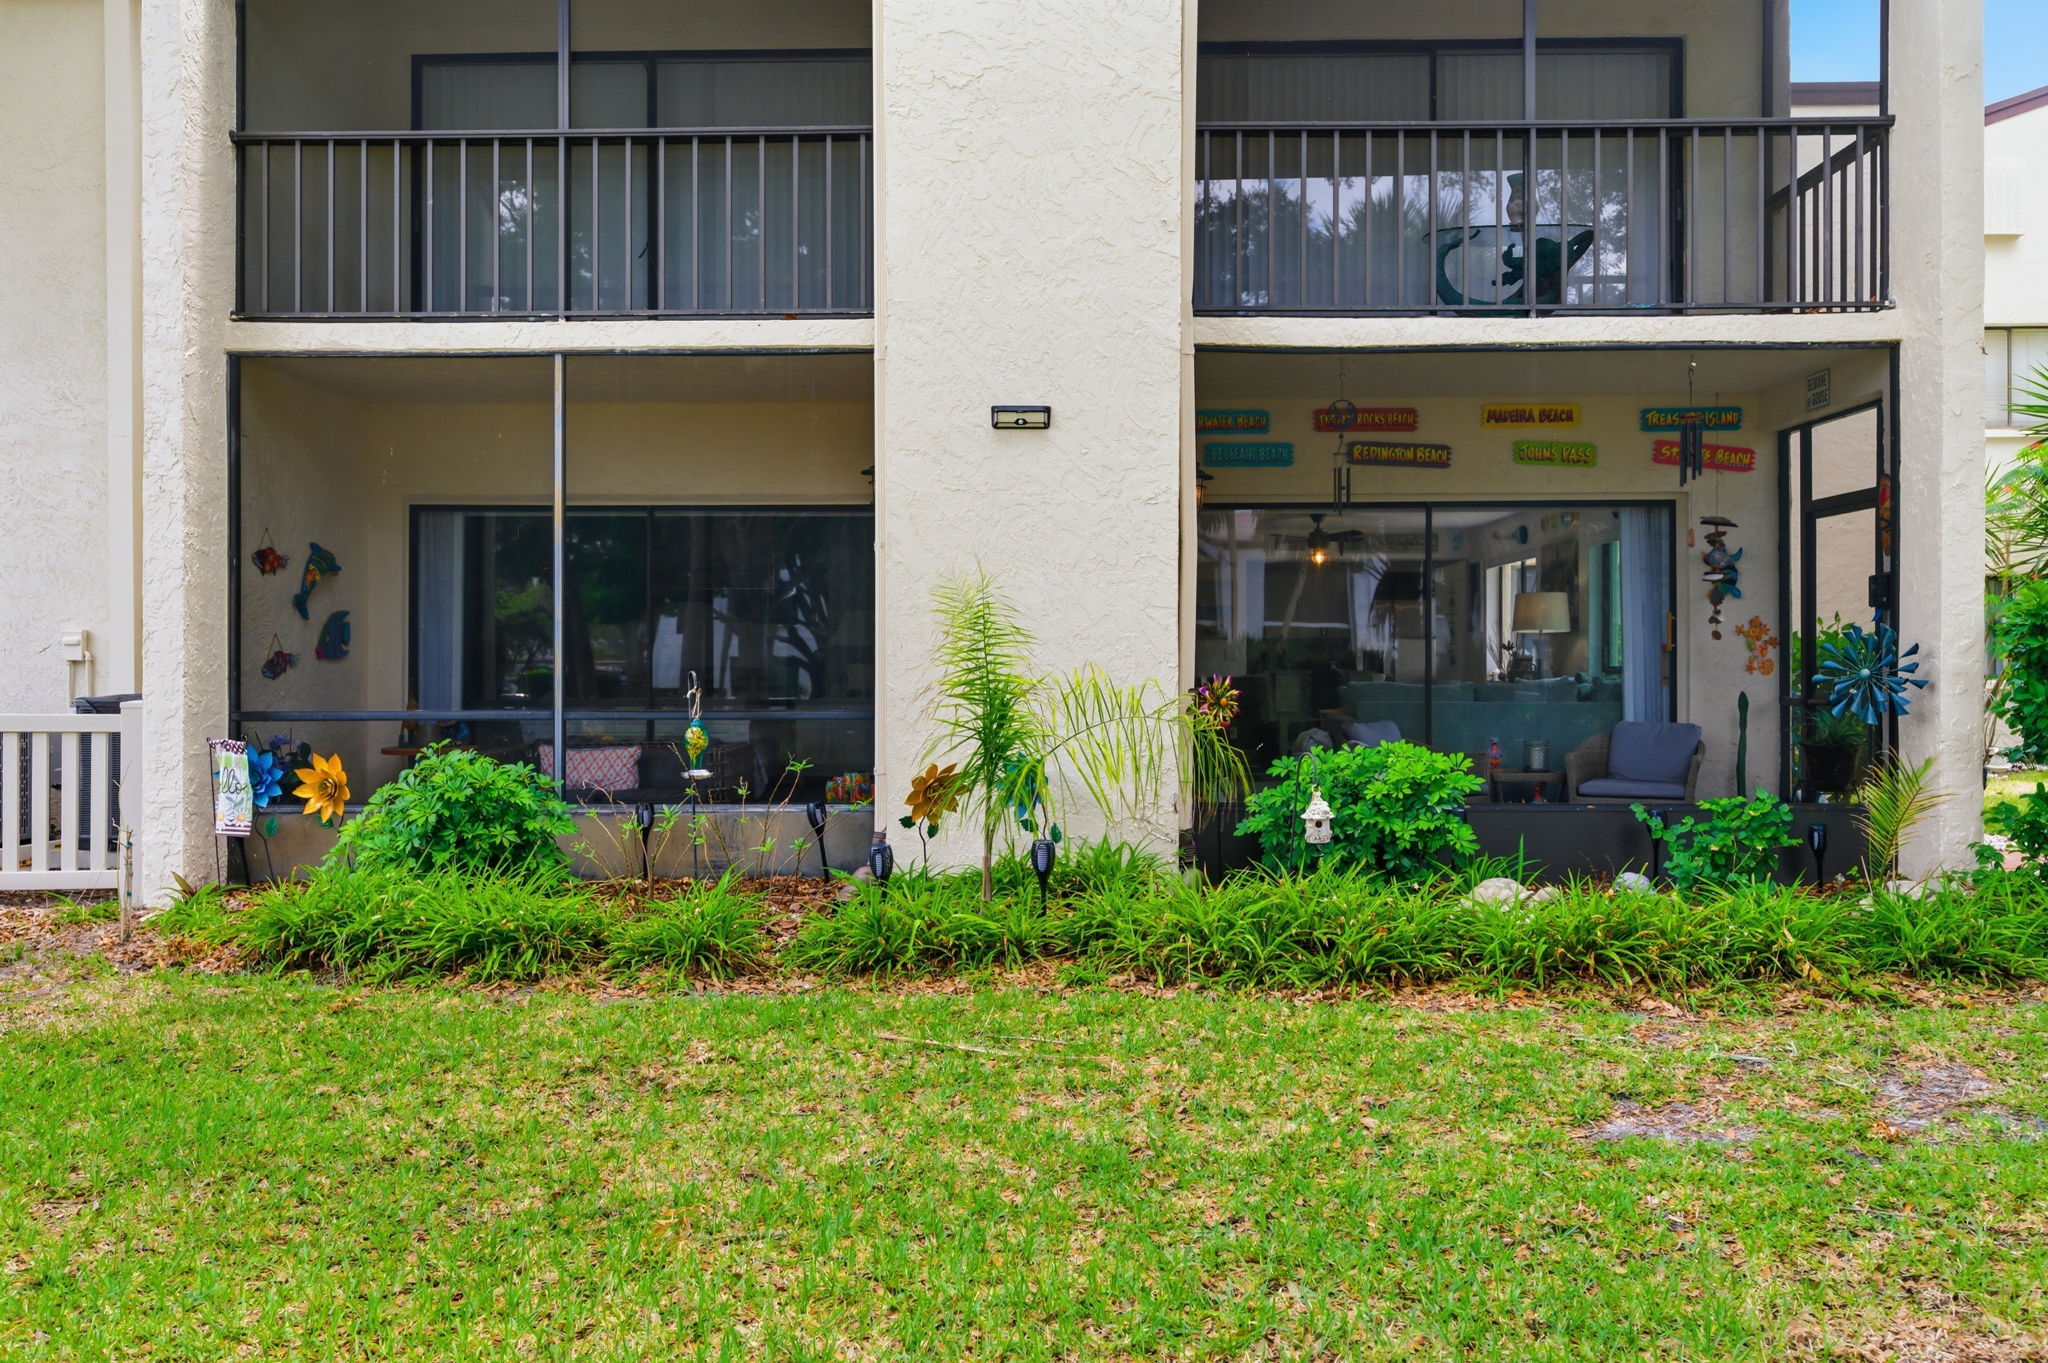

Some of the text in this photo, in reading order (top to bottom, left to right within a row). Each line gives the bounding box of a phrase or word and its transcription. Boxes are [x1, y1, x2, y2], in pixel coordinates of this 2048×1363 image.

[1236, 414, 1266, 428] BEACH
[1357, 412, 1385, 425] ROCKS
[1387, 413, 1414, 425] BEACH
[1486, 408, 1574, 423] MADEIRA BEACH
[1705, 411, 1739, 426] ISLAND
[1258, 447, 1288, 461] BEACH
[1352, 445, 1448, 463] REDINGTON BEACH
[1562, 446, 1592, 463] PASS
[1715, 448, 1750, 465] BEACH
